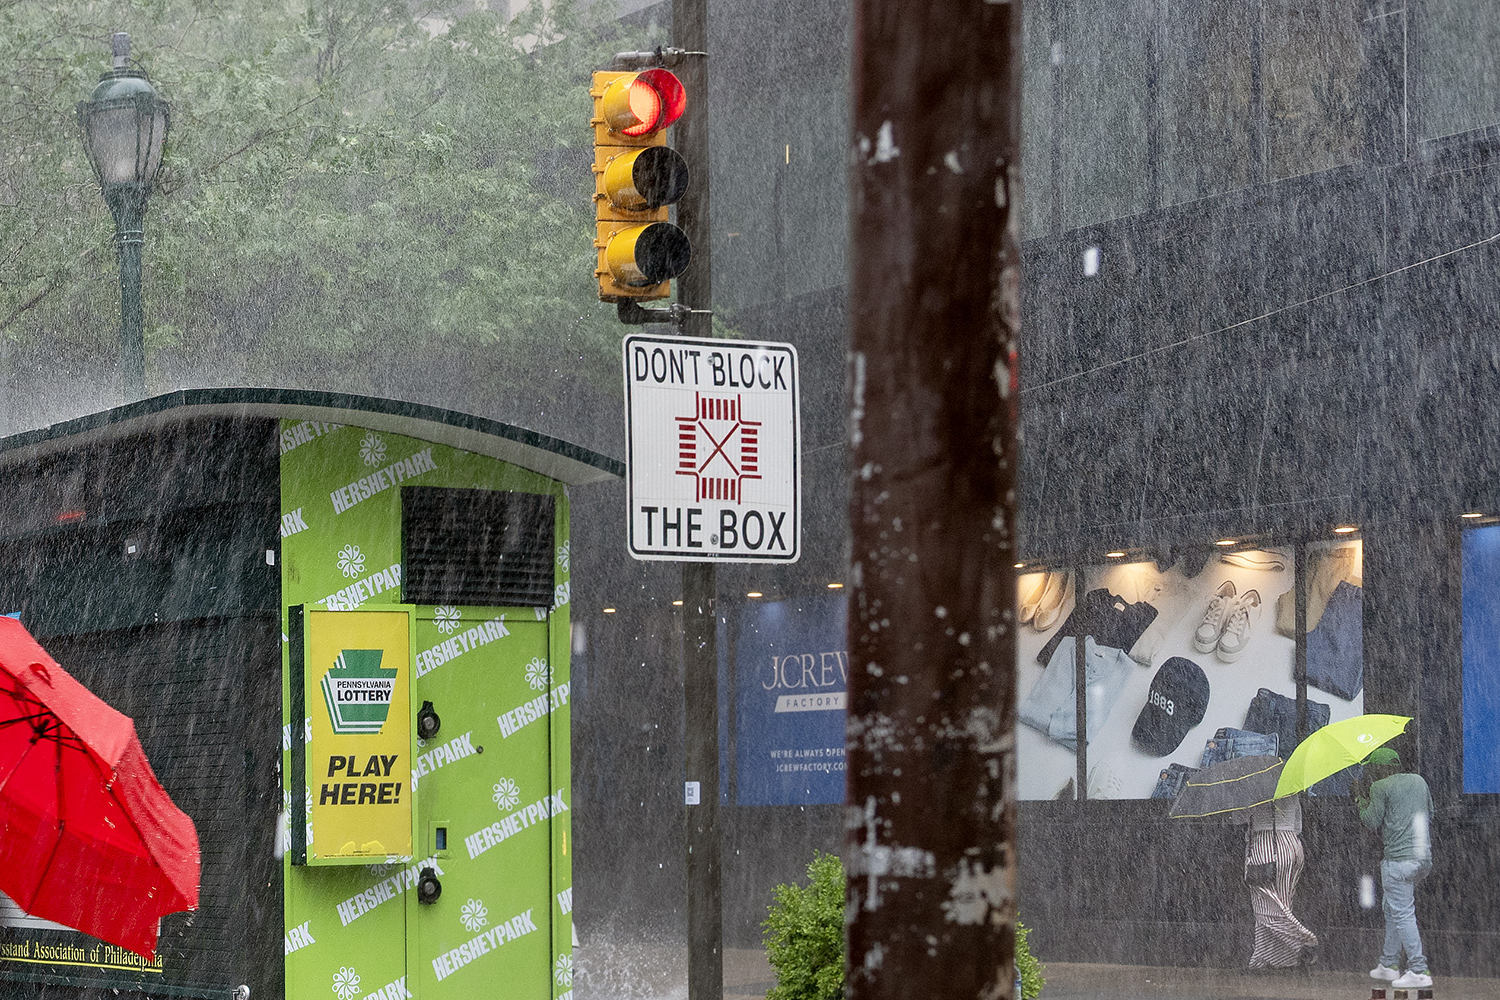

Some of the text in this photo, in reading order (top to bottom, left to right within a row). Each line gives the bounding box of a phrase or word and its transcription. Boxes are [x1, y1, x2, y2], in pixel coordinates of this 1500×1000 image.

[634, 346, 788, 391] DON'T BLOCK
[329, 447, 438, 515] HERSHEYPARK
[641, 506, 787, 551] THE BOX
[337, 681, 391, 689] PENNSYLVANIA
[337, 690, 391, 702] LOTTERY
[497, 681, 570, 739] HERSHEYP
[786, 697, 840, 708] FACTORY
[770, 748, 846, 759] WE'RE ALWAYS OPEN
[327, 755, 398, 778] PLAY
[319, 782, 402, 806] HERE!
[464, 788, 569, 860] HERSHEYPARK
[34, 941, 85, 962] Association
[90, 945, 100, 962] of
[431, 908, 537, 982] HERSHEYPARK
